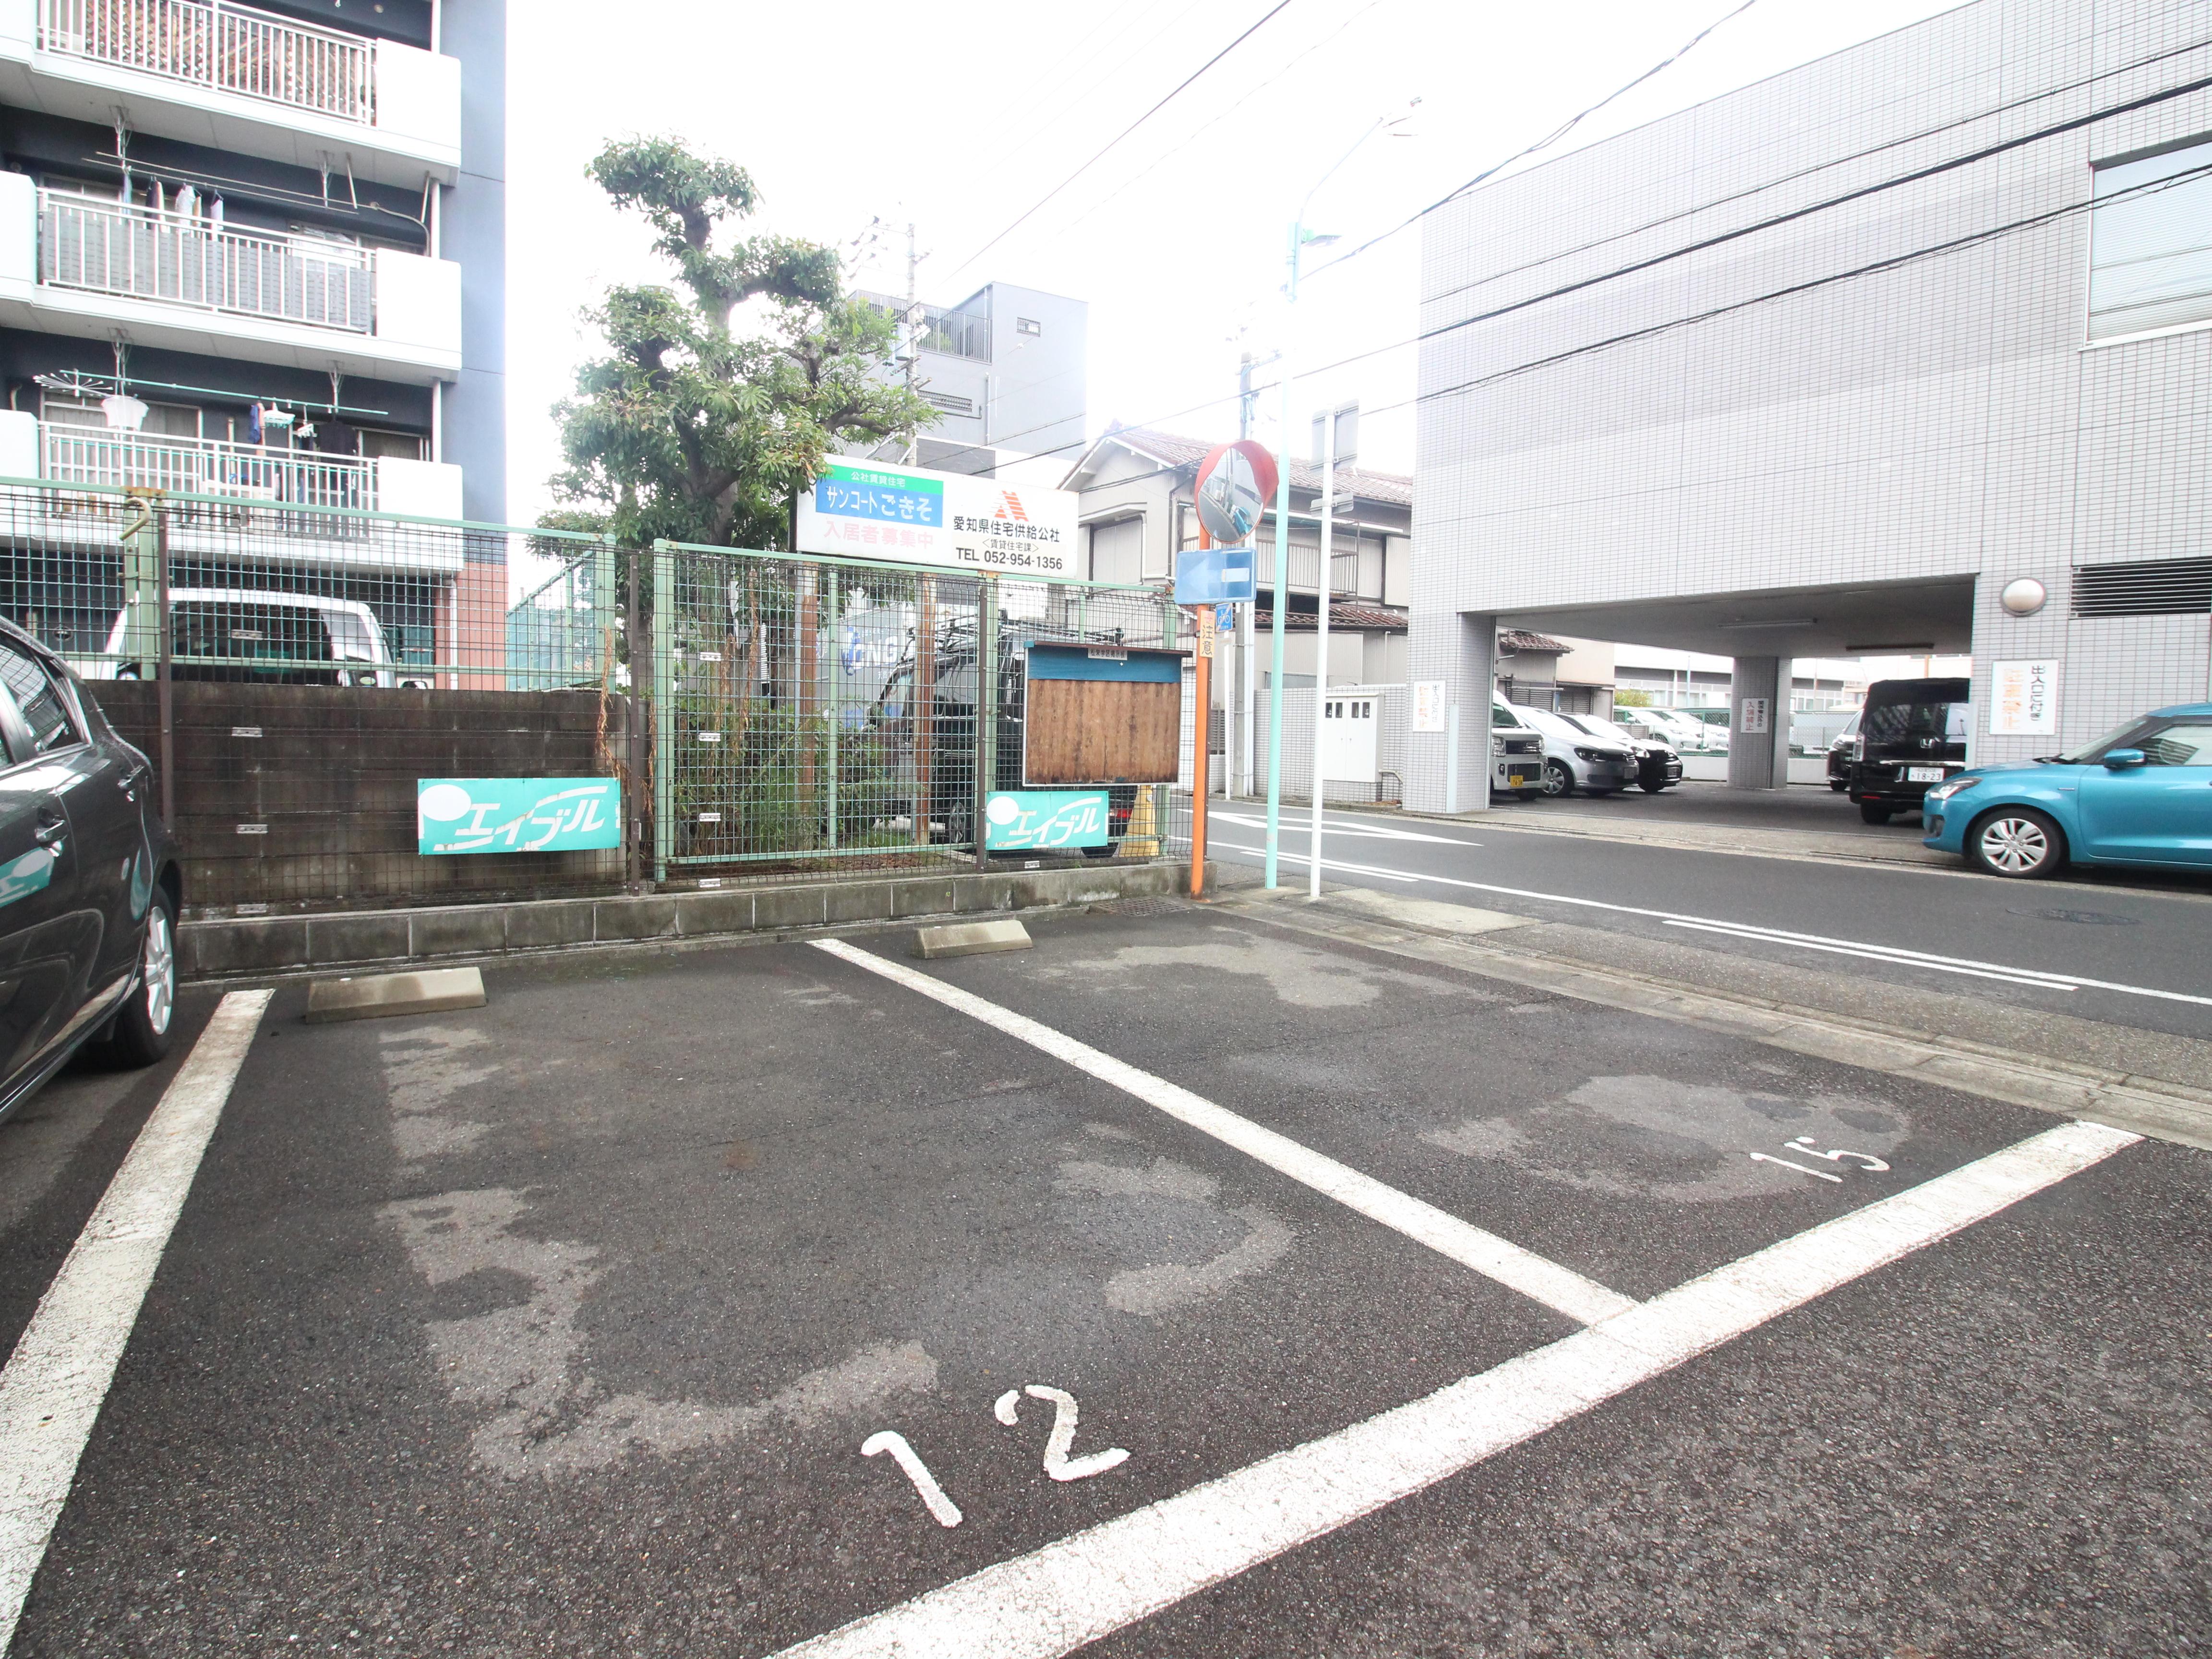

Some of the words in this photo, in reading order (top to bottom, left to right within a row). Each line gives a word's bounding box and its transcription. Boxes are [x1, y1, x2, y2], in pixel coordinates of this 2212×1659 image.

[851, 471, 906, 488] 公社賃貸住宅
[826, 485, 933, 522] サンコートごきそ
[824, 520, 934, 550] 入居者募集中
[953, 516, 1060, 543] 愛知県住宅供給公社
[956, 547, 980, 562] TEL
[984, 550, 1063, 570] 052-954-1356
[455, 799, 606, 848] エイブル
[1009, 807, 1100, 846] エイブル
[1750, 1136, 1892, 1183] 15
[861, 1384, 1131, 1528] 12
